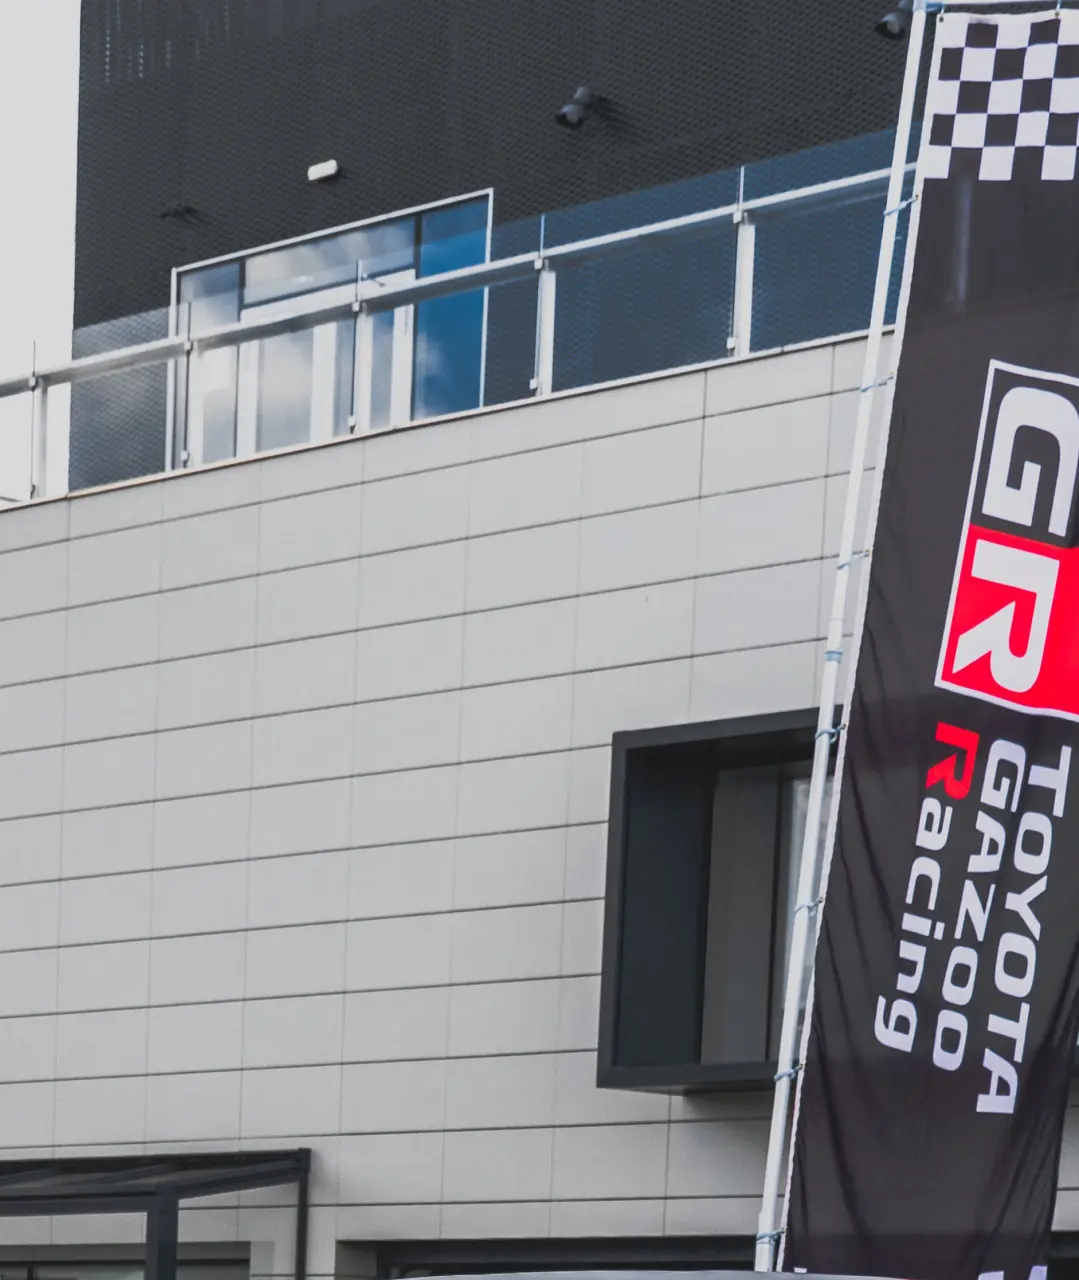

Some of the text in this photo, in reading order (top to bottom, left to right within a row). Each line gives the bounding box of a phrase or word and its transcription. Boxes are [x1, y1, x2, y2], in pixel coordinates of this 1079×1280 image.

[951, 386, 1079, 694] GR
[874, 721, 980, 1053] Racing
[932, 738, 1027, 1072] GAZOO
[976, 744, 1071, 1114] TOYOTA
